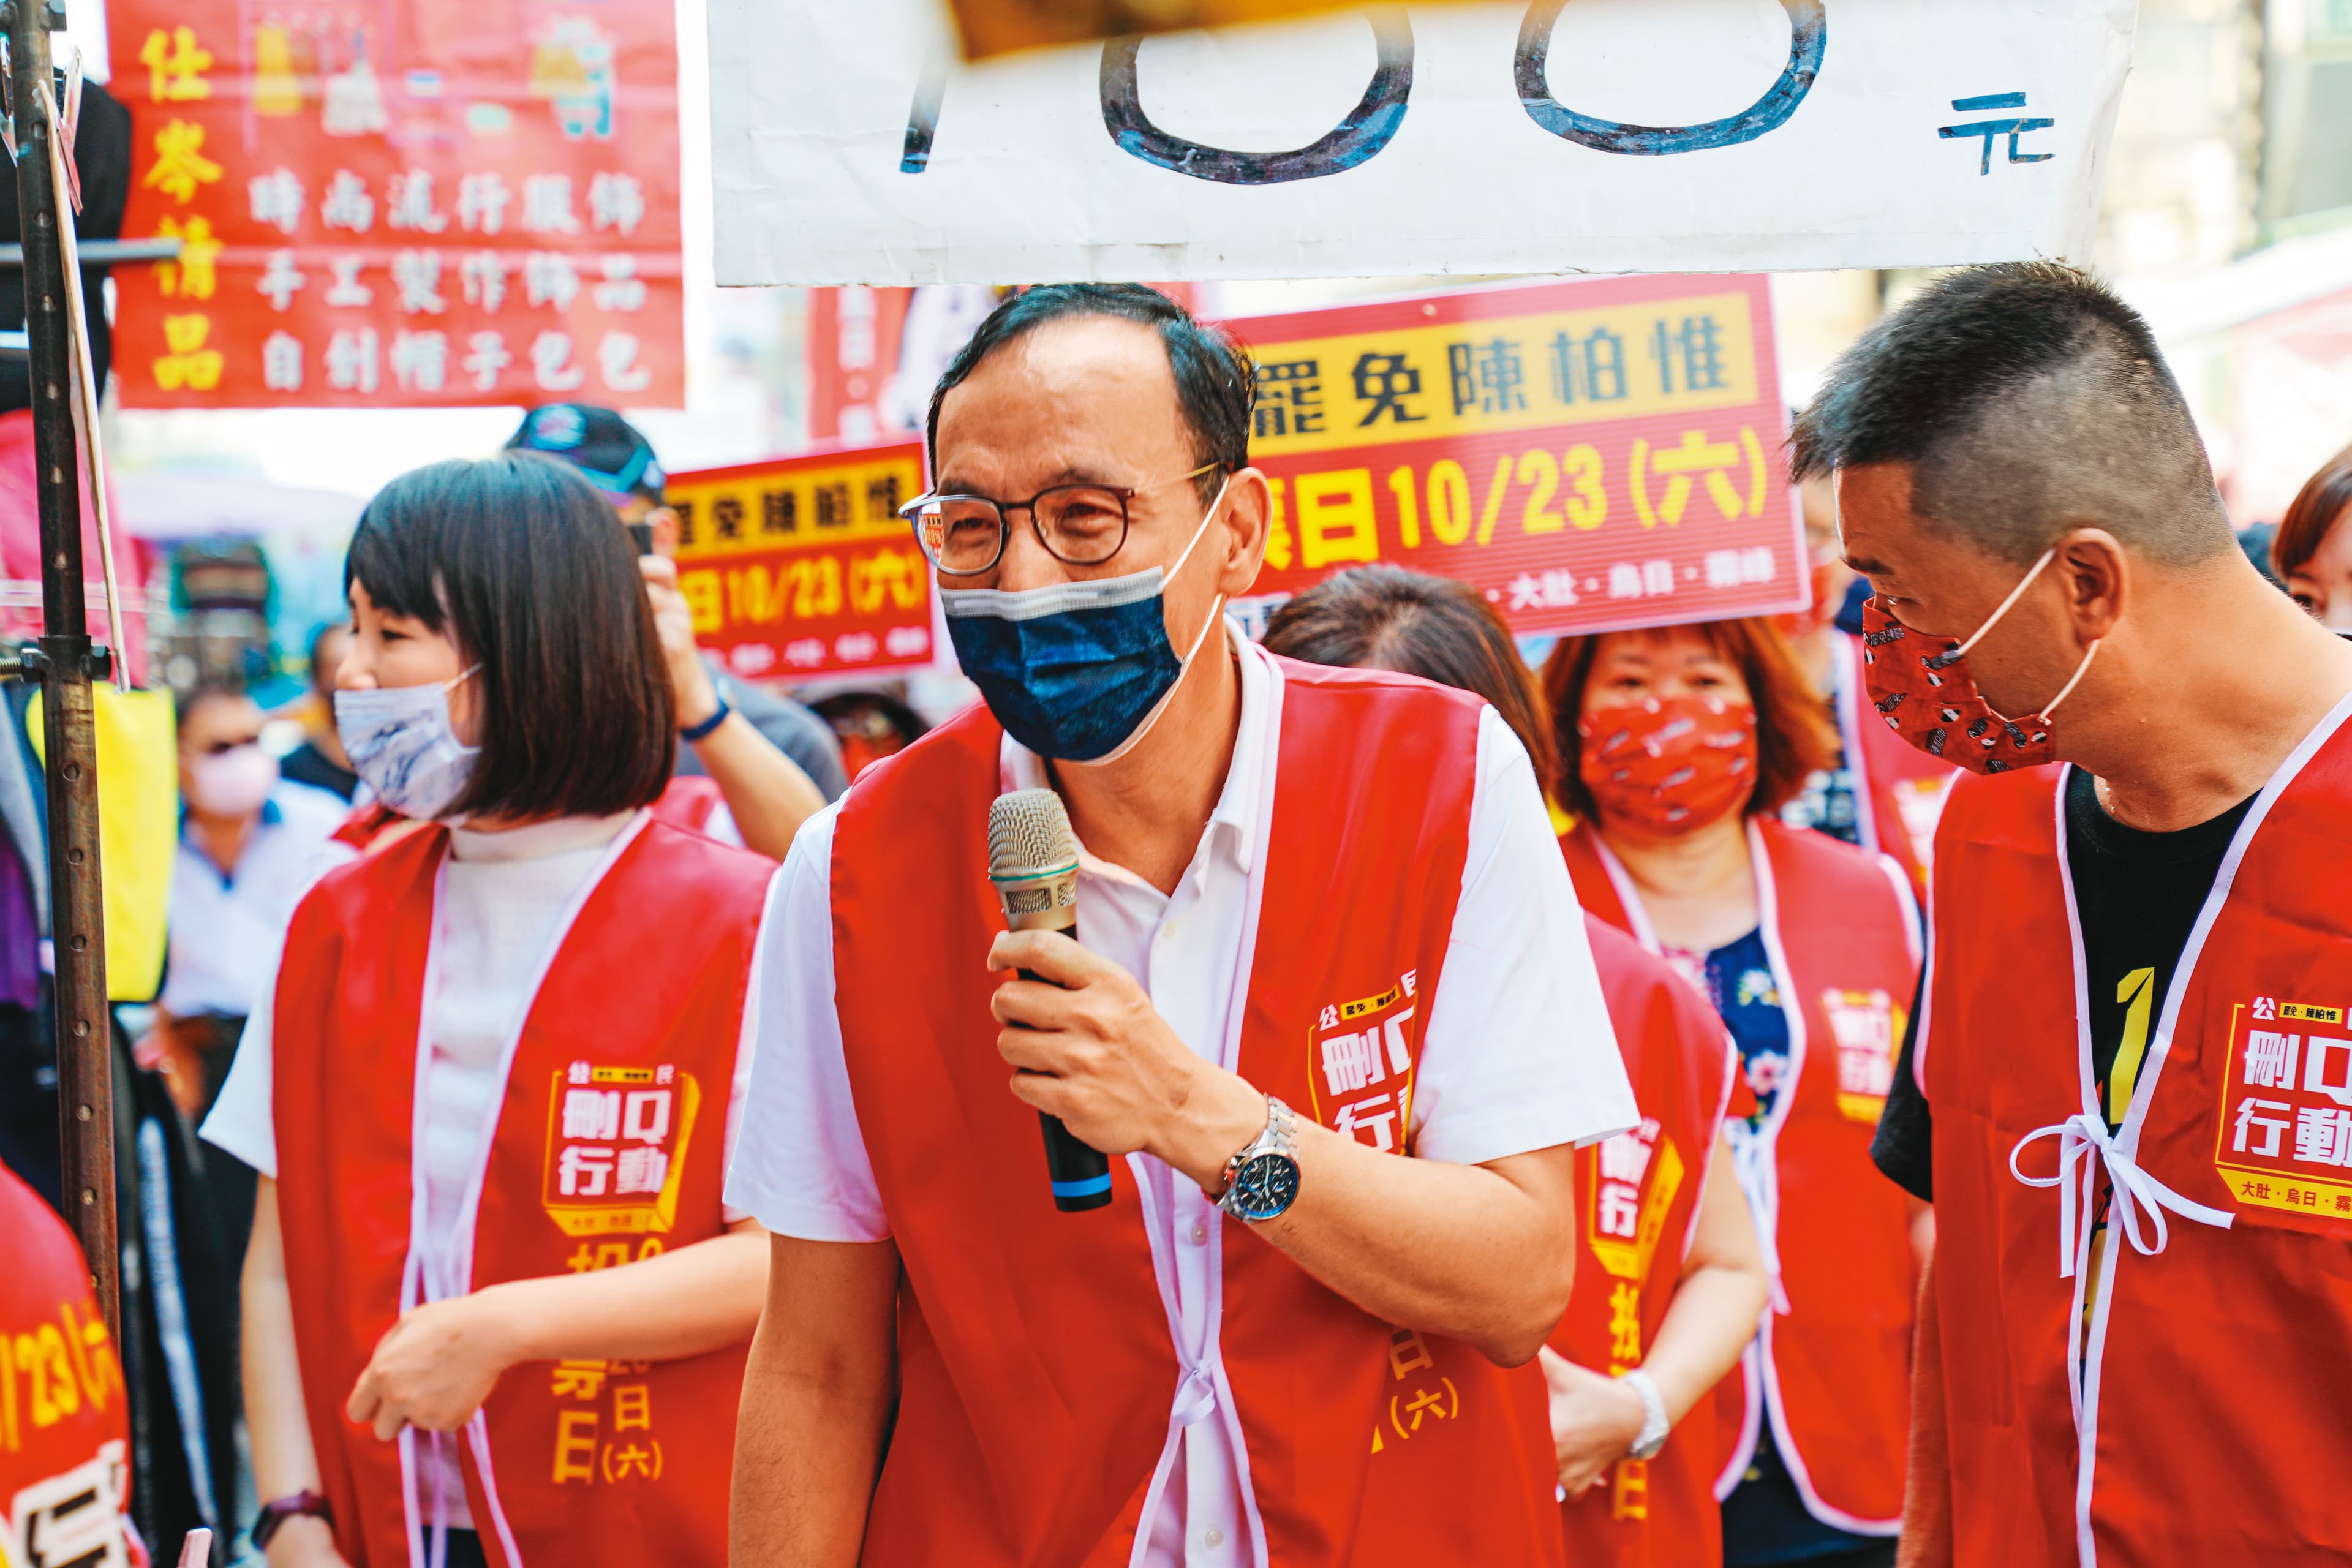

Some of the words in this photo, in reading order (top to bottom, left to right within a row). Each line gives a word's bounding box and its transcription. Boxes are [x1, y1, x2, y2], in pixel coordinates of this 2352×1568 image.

[1937, 91, 2055, 175] 元
[1255, 314, 1731, 438] 罷免陳柏惟
[2252, 997, 2276, 1020] 公
[2233, 1097, 2352, 1168] 行動
[558, 1145, 668, 1196] 行動
